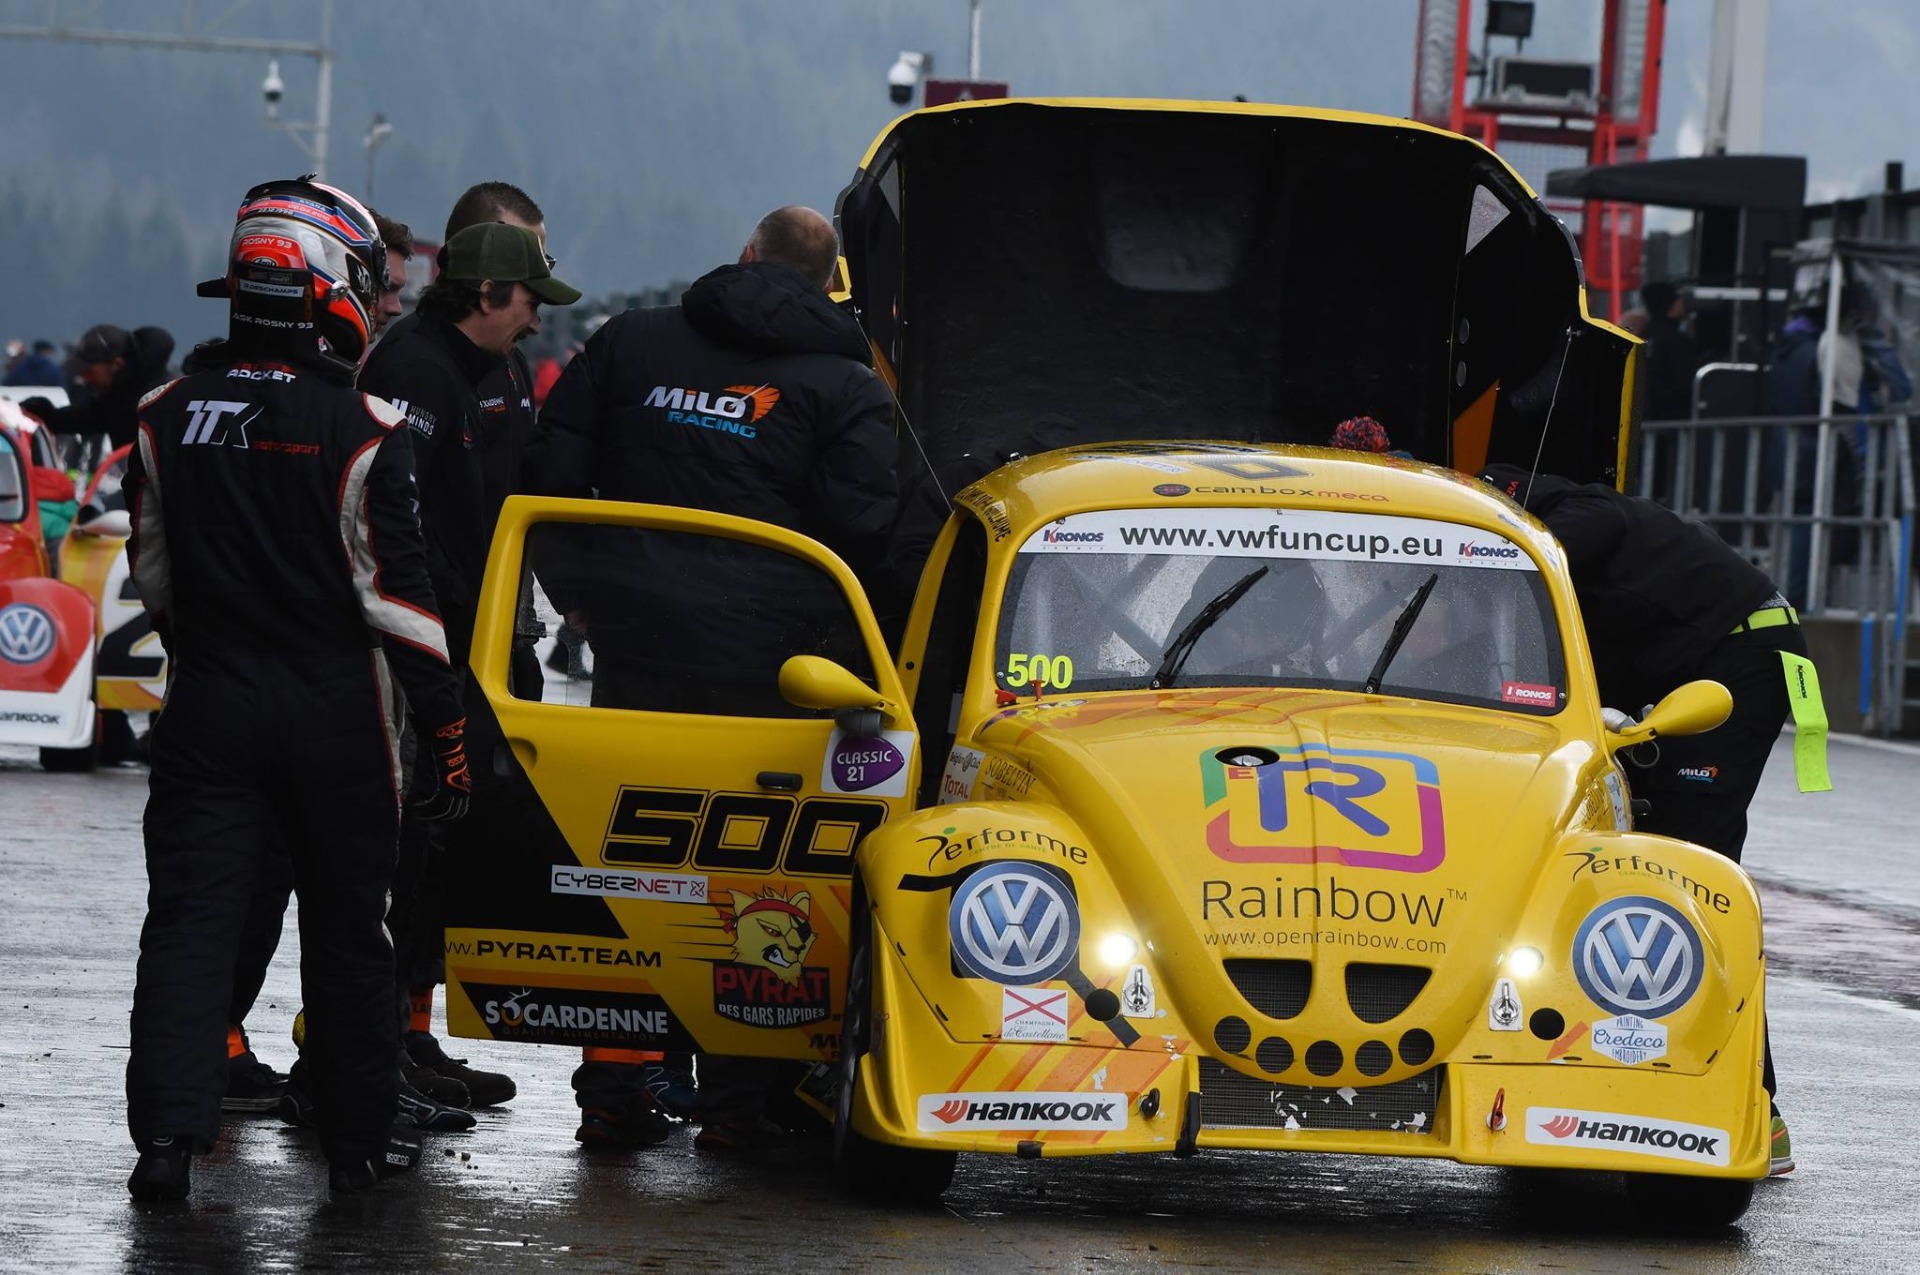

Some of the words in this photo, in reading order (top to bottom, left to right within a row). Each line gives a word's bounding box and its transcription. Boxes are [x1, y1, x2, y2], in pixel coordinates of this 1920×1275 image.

[242, 237, 275, 246] ROSNY
[276, 239, 293, 249] 93
[254, 317, 296, 328] ROSNY
[297, 321, 314, 329] 93
[408, 413, 435, 436] MINDS
[410, 405, 437, 425] HUNGRY
[667, 411, 757, 439] RACING
[1043, 525, 1105, 544] KRONOS
[1119, 525, 1443, 559] www.vwfuncup.eu
[1458, 540, 1519, 559] KRONOS
[1006, 653, 1073, 690] 500
[836, 749, 893, 765] CLASSIC
[847, 766, 865, 782] 21
[600, 785, 889, 880] 500
[553, 871, 688, 896] CYBERNET
[1203, 876, 1445, 928] Rainbow
[1203, 928, 1447, 954] www.openrainbow.com
[715, 966, 829, 1004] PYRAT
[484, 997, 669, 1034] SOCARDENNE
[718, 1003, 740, 1018] DES
[743, 1006, 775, 1026] GARS
[777, 1008, 826, 1026] RAPIDES
[1593, 1028, 1666, 1049] Credeco
